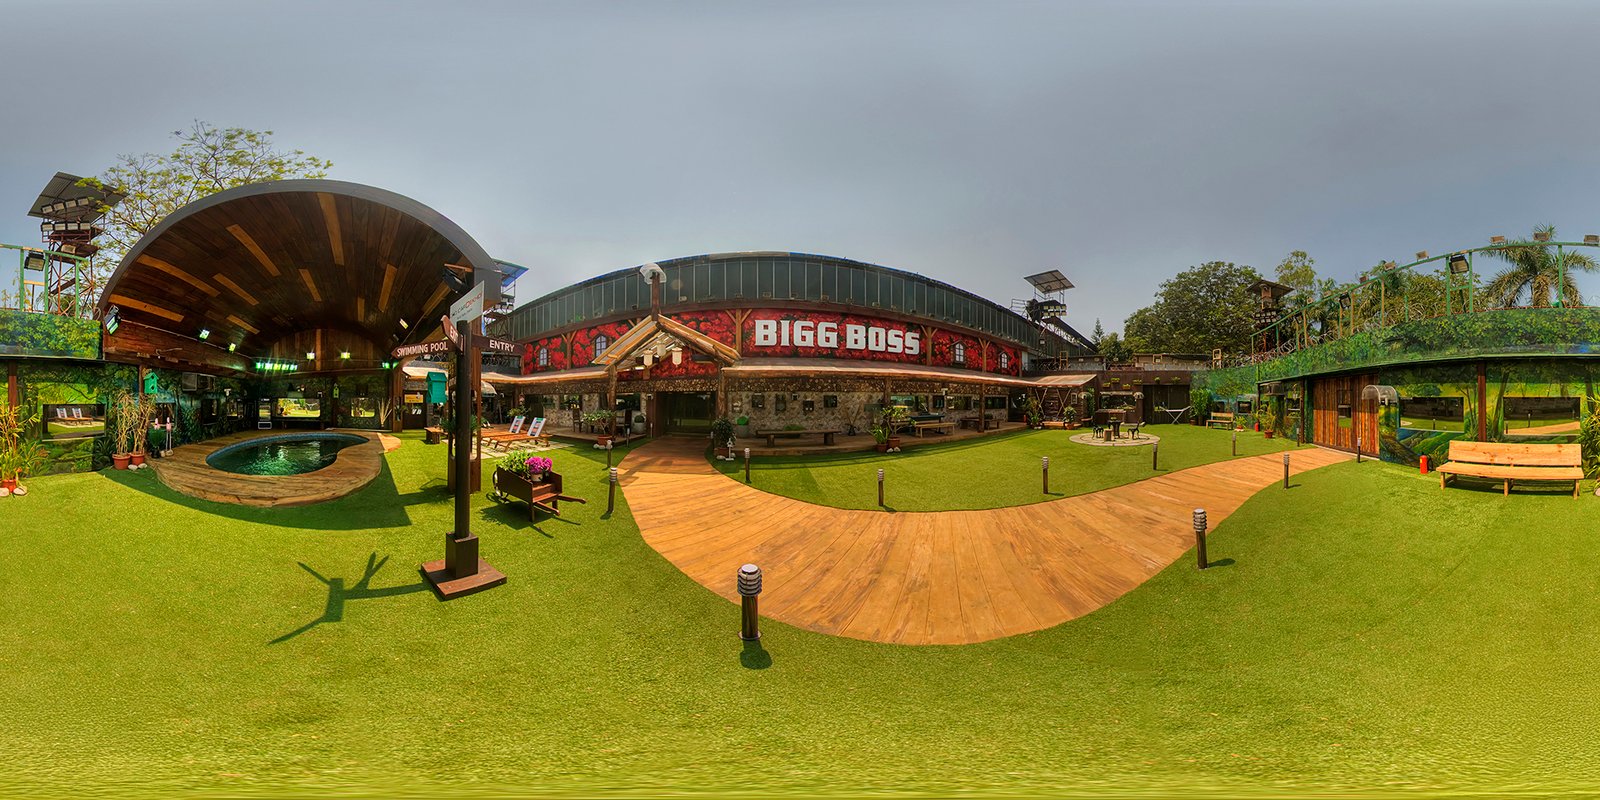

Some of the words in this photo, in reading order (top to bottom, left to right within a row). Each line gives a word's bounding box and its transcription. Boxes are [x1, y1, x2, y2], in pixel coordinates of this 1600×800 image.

[754, 319, 839, 349] BIGG
[845, 323, 920, 355] BOSS
[396, 344, 428, 357] SWIMMING
[430, 341, 448, 352] POOL
[489, 340, 515, 353] ENTRY
